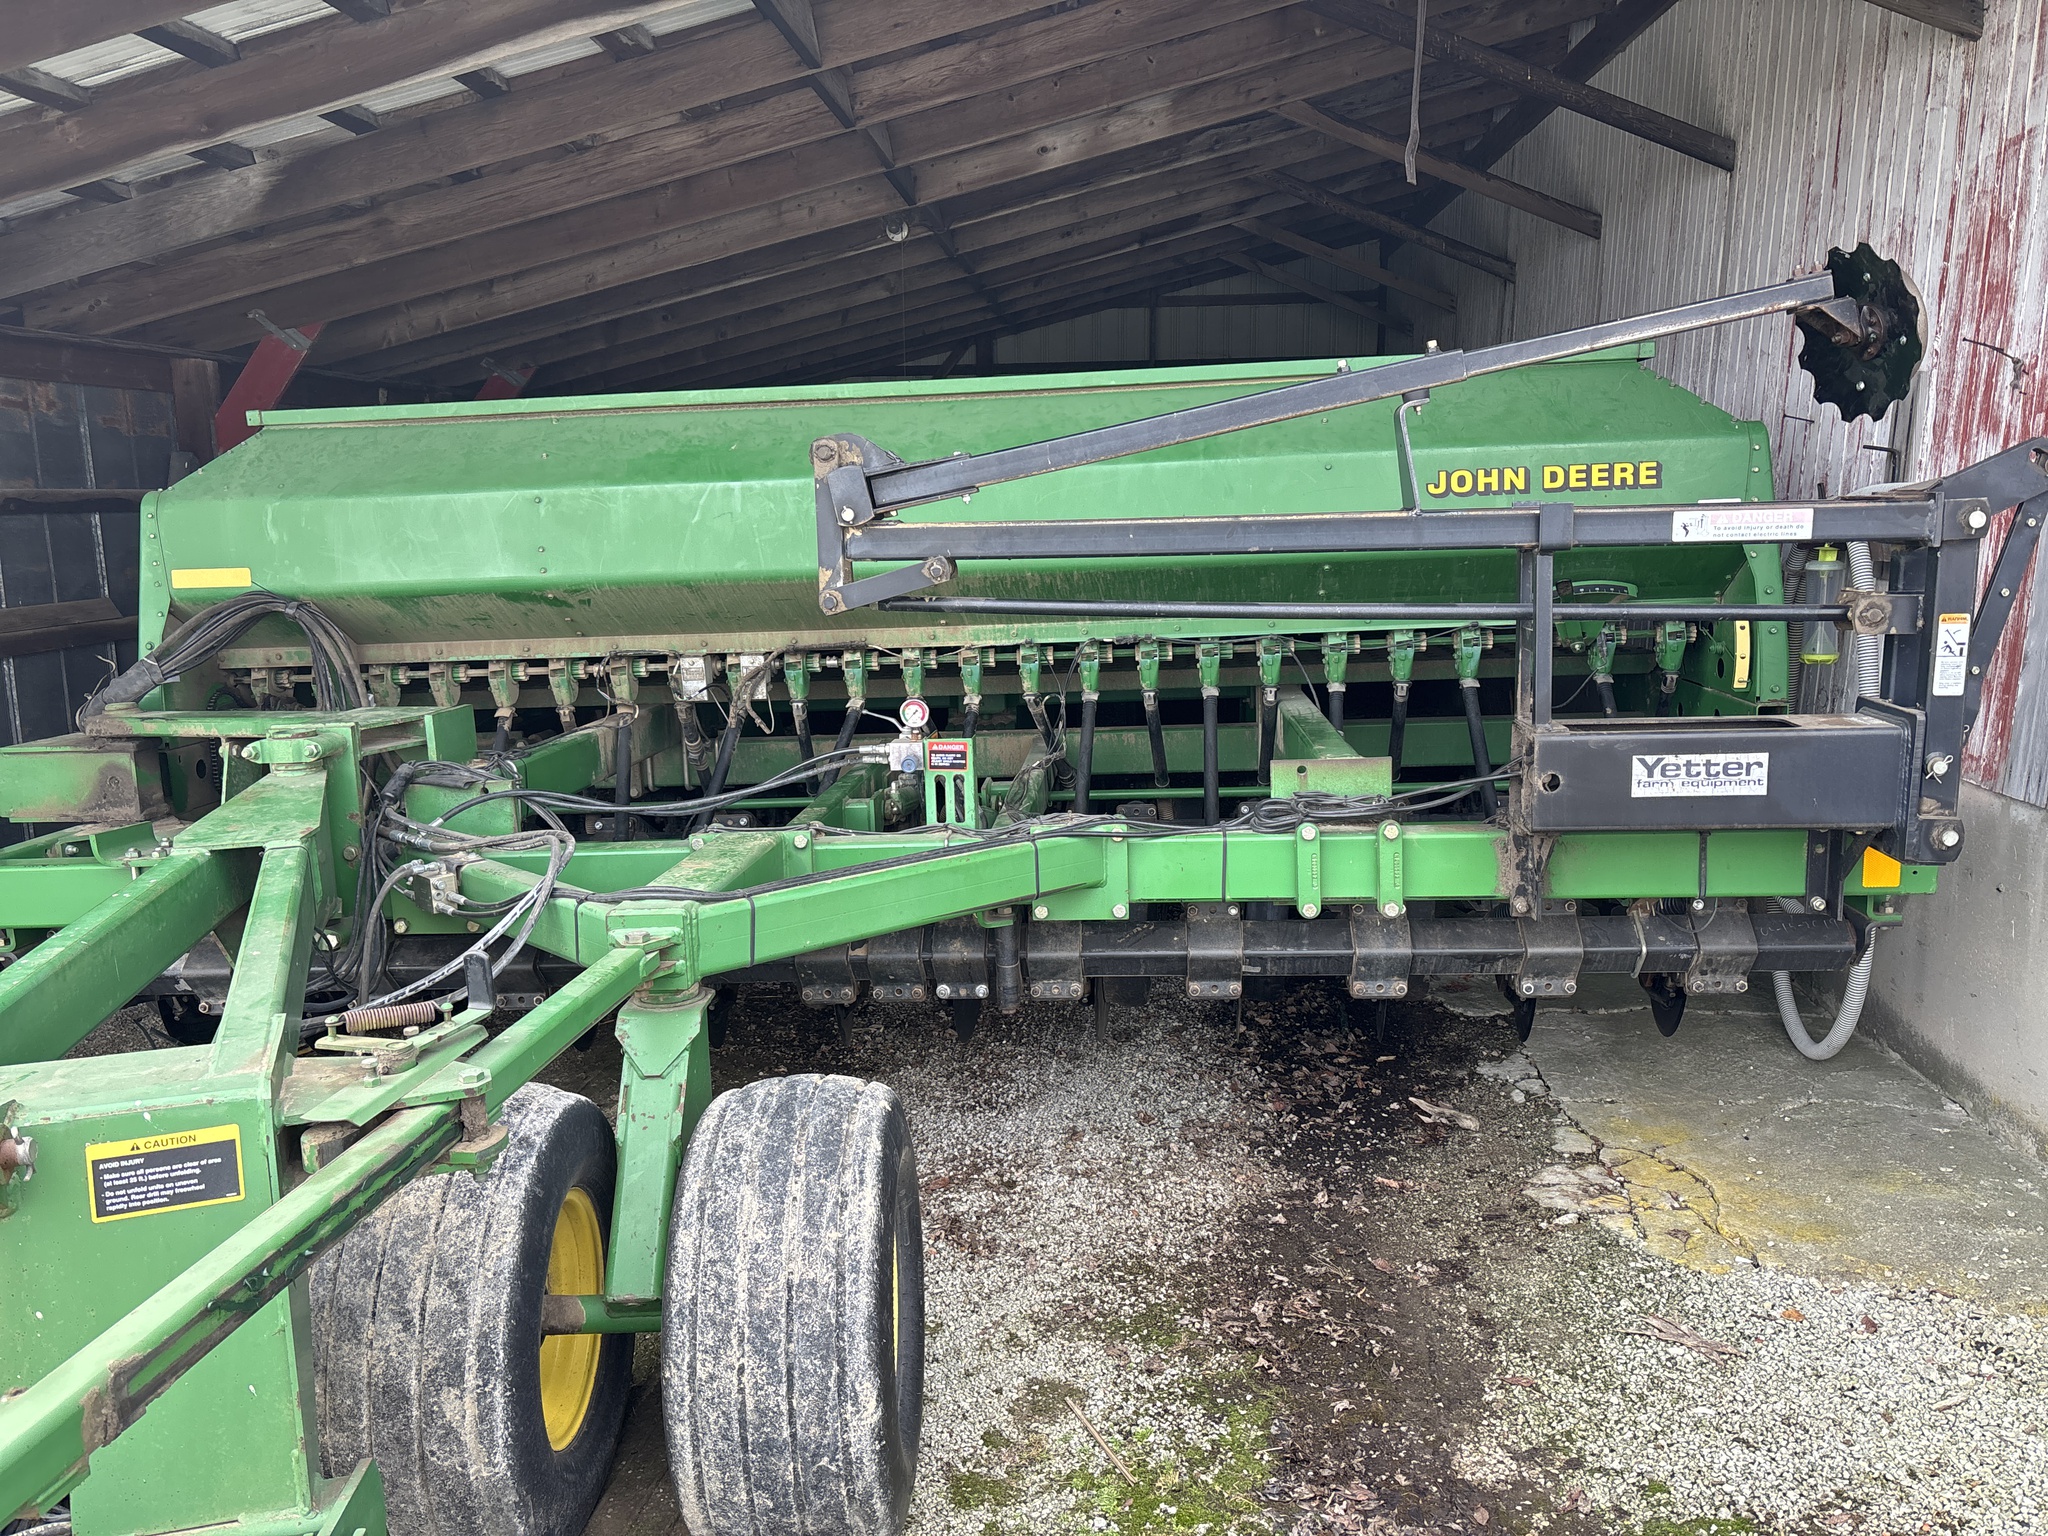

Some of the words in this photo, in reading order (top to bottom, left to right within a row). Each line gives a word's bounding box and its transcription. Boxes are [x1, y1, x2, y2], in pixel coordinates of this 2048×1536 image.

[1426, 466, 1530, 498] JOHN
[1542, 460, 1663, 493] DEERE
[1732, 512, 1793, 523] DANGER
[1636, 757, 1763, 778] Yetter
[1637, 779, 1673, 788] farm
[1681, 778, 1764, 789] equipment
[144, 1134, 196, 1149] CAUTION
[99, 1162, 119, 1170] AVOID
[120, 1158, 144, 1167] INJURY
[136, 1168, 144, 1176] all
[146, 1166, 171, 1175] persons
[114, 1178, 128, 1186] least
[148, 1173, 169, 1181] before
[127, 1186, 147, 1194] unfold
[175, 1179, 198, 1187] uneven
[161, 1189, 174, 1197] may
[106, 1202, 128, 1211] rapidly
